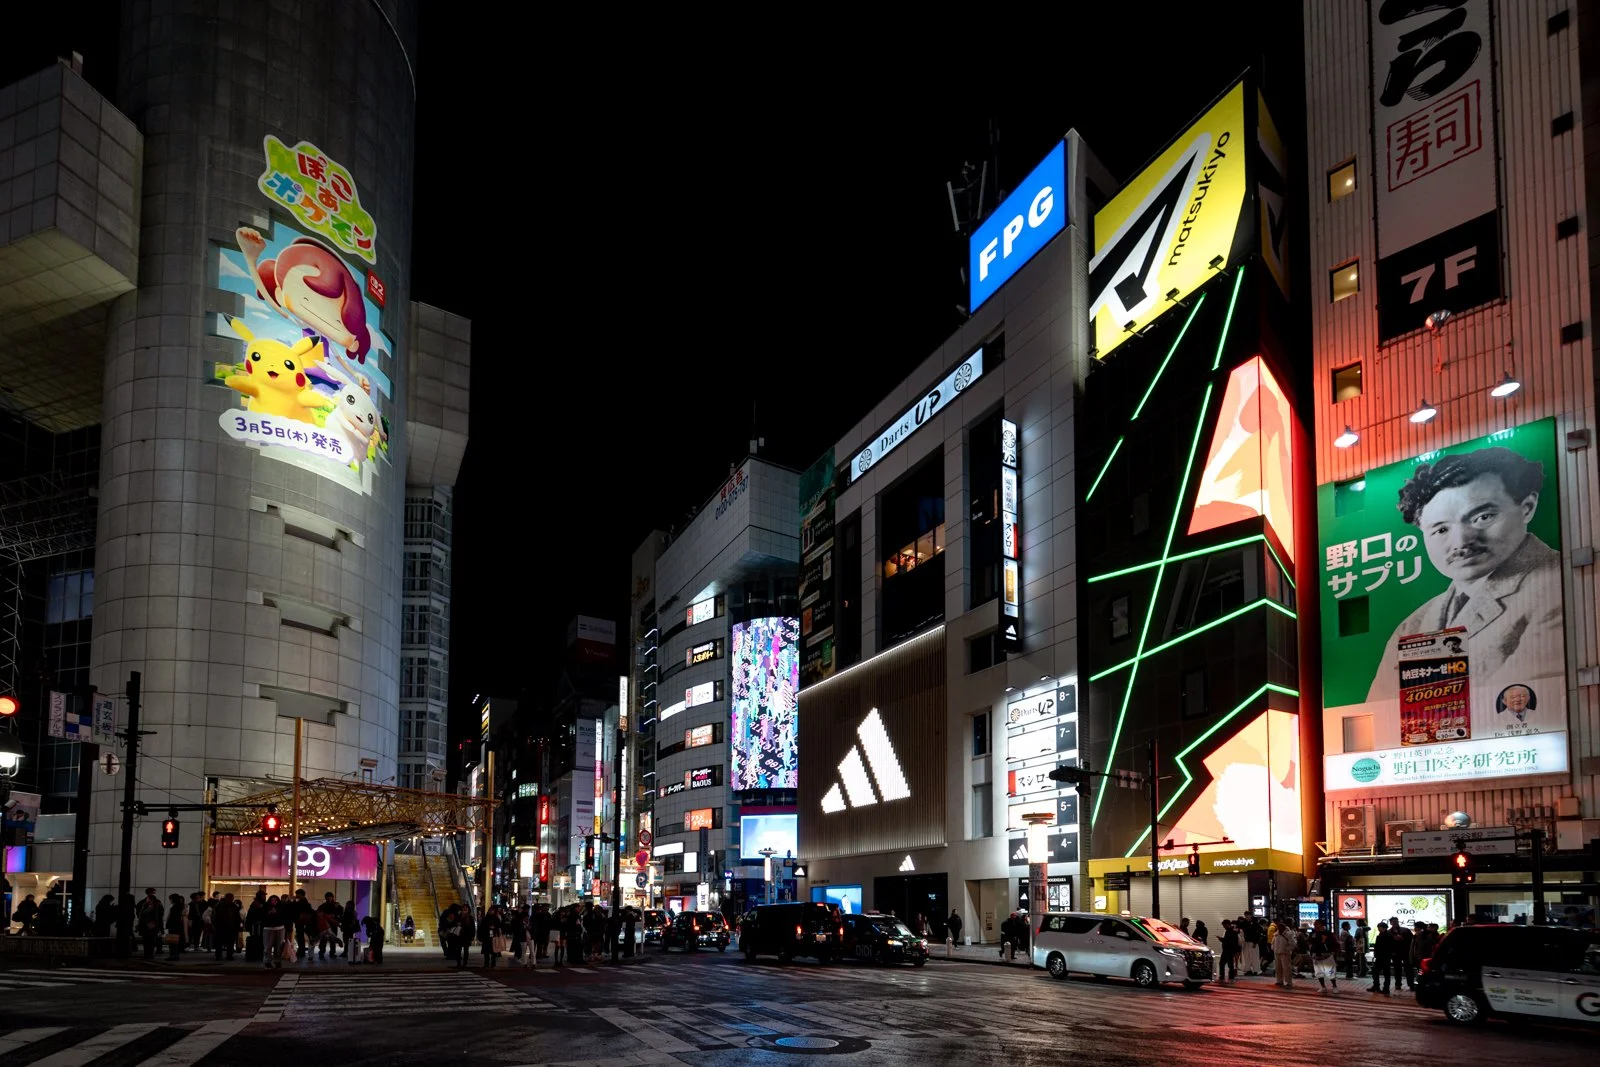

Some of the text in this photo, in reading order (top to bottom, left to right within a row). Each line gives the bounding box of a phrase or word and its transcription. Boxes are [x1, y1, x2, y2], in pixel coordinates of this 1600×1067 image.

[1396, 93, 1471, 181] 寿司
[265, 172, 373, 250] ポケモン
[1168, 131, 1231, 267] matsukiyo
[979, 186, 1054, 282] FPG
[1401, 246, 1477, 304] 7F
[880, 389, 942, 452] Darts UP
[1326, 532, 1418, 572] 野口の
[1327, 556, 1422, 599] サプリ
[1402, 661, 1468, 680] 納豆キナーゼHQ
[1405, 683, 1464, 703] 4000FU
[1393, 748, 1538, 775] 野口医学研究所
[285, 844, 331, 877] 109
[1213, 858, 1255, 867] matsukiyo
